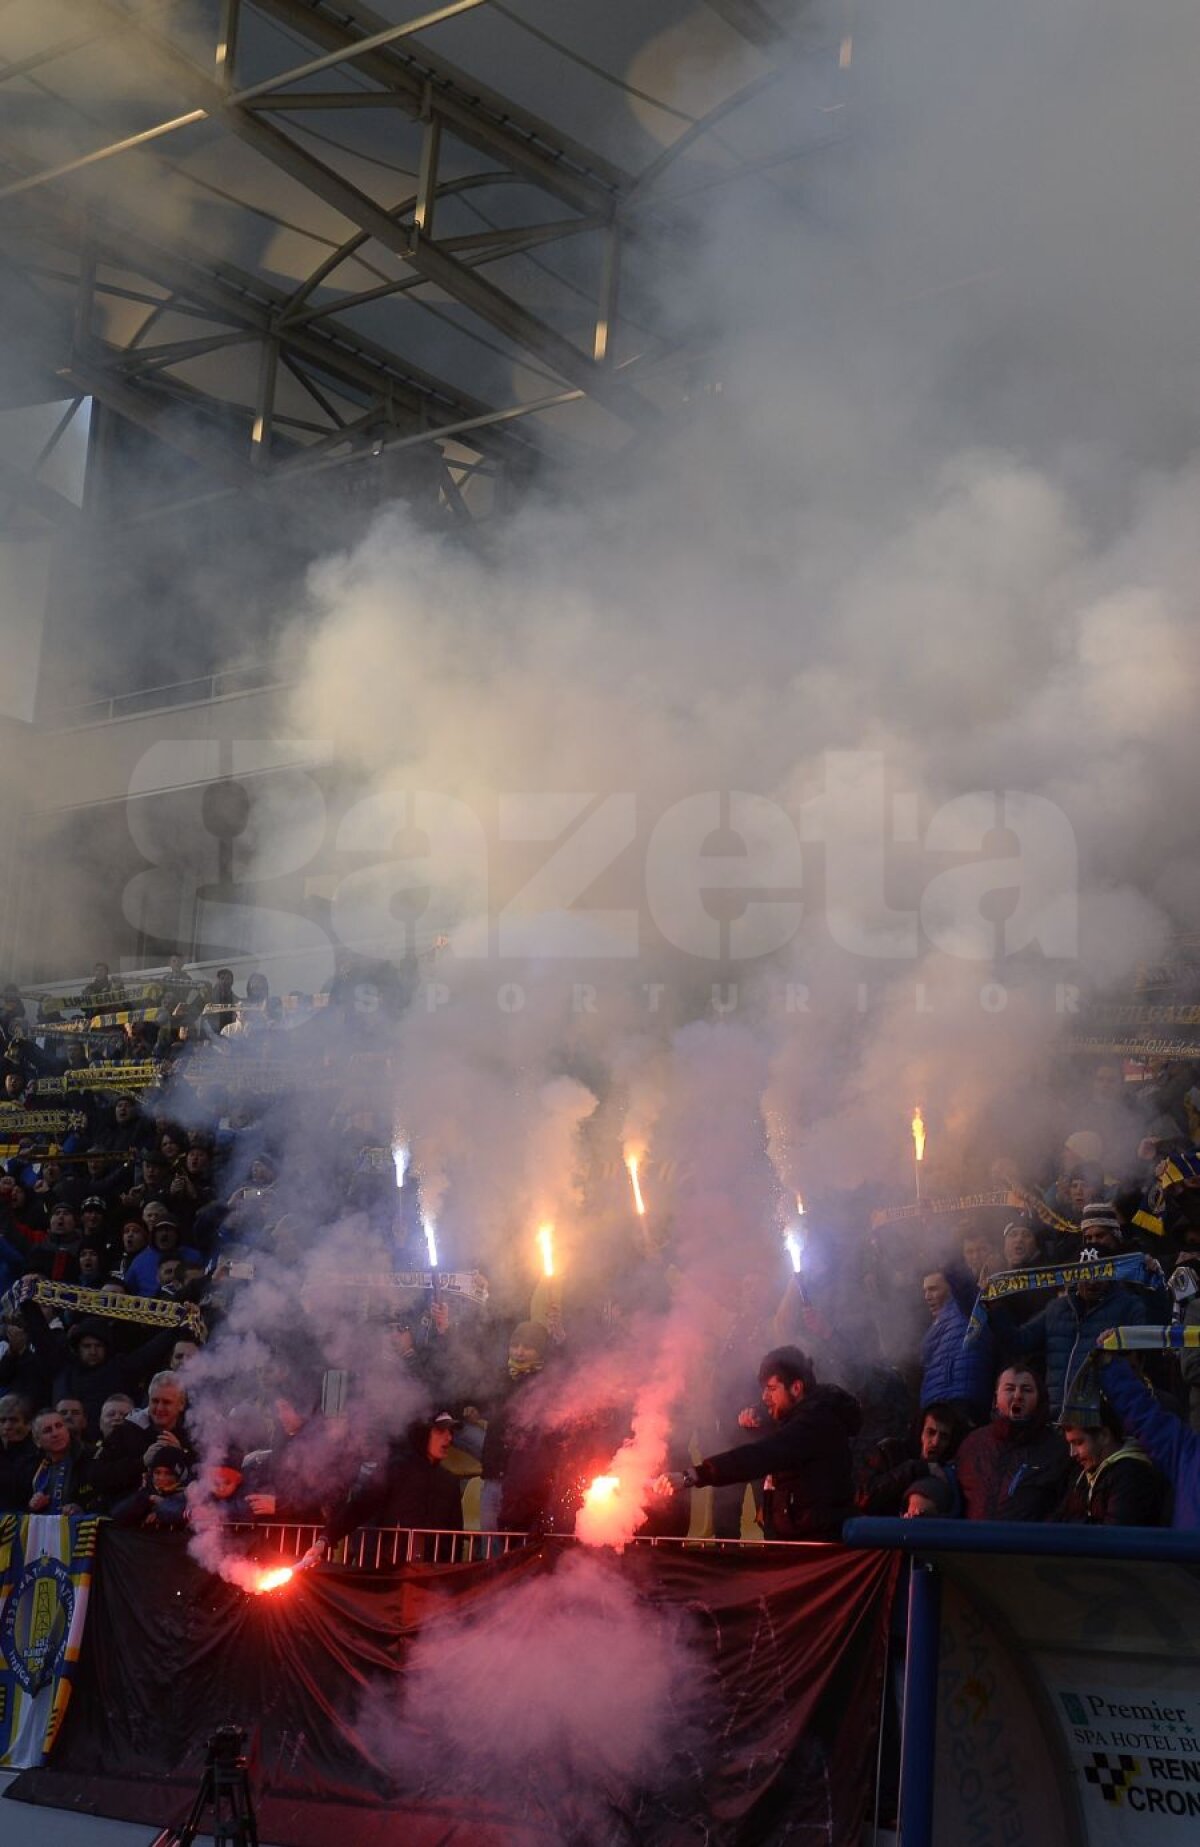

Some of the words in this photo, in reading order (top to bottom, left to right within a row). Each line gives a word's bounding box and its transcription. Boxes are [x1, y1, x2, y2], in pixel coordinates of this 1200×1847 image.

[1087, 1695, 1186, 1722] Premier
[1073, 1728, 1109, 1746] SPA
[1112, 1731, 1176, 1751] HOTEL
